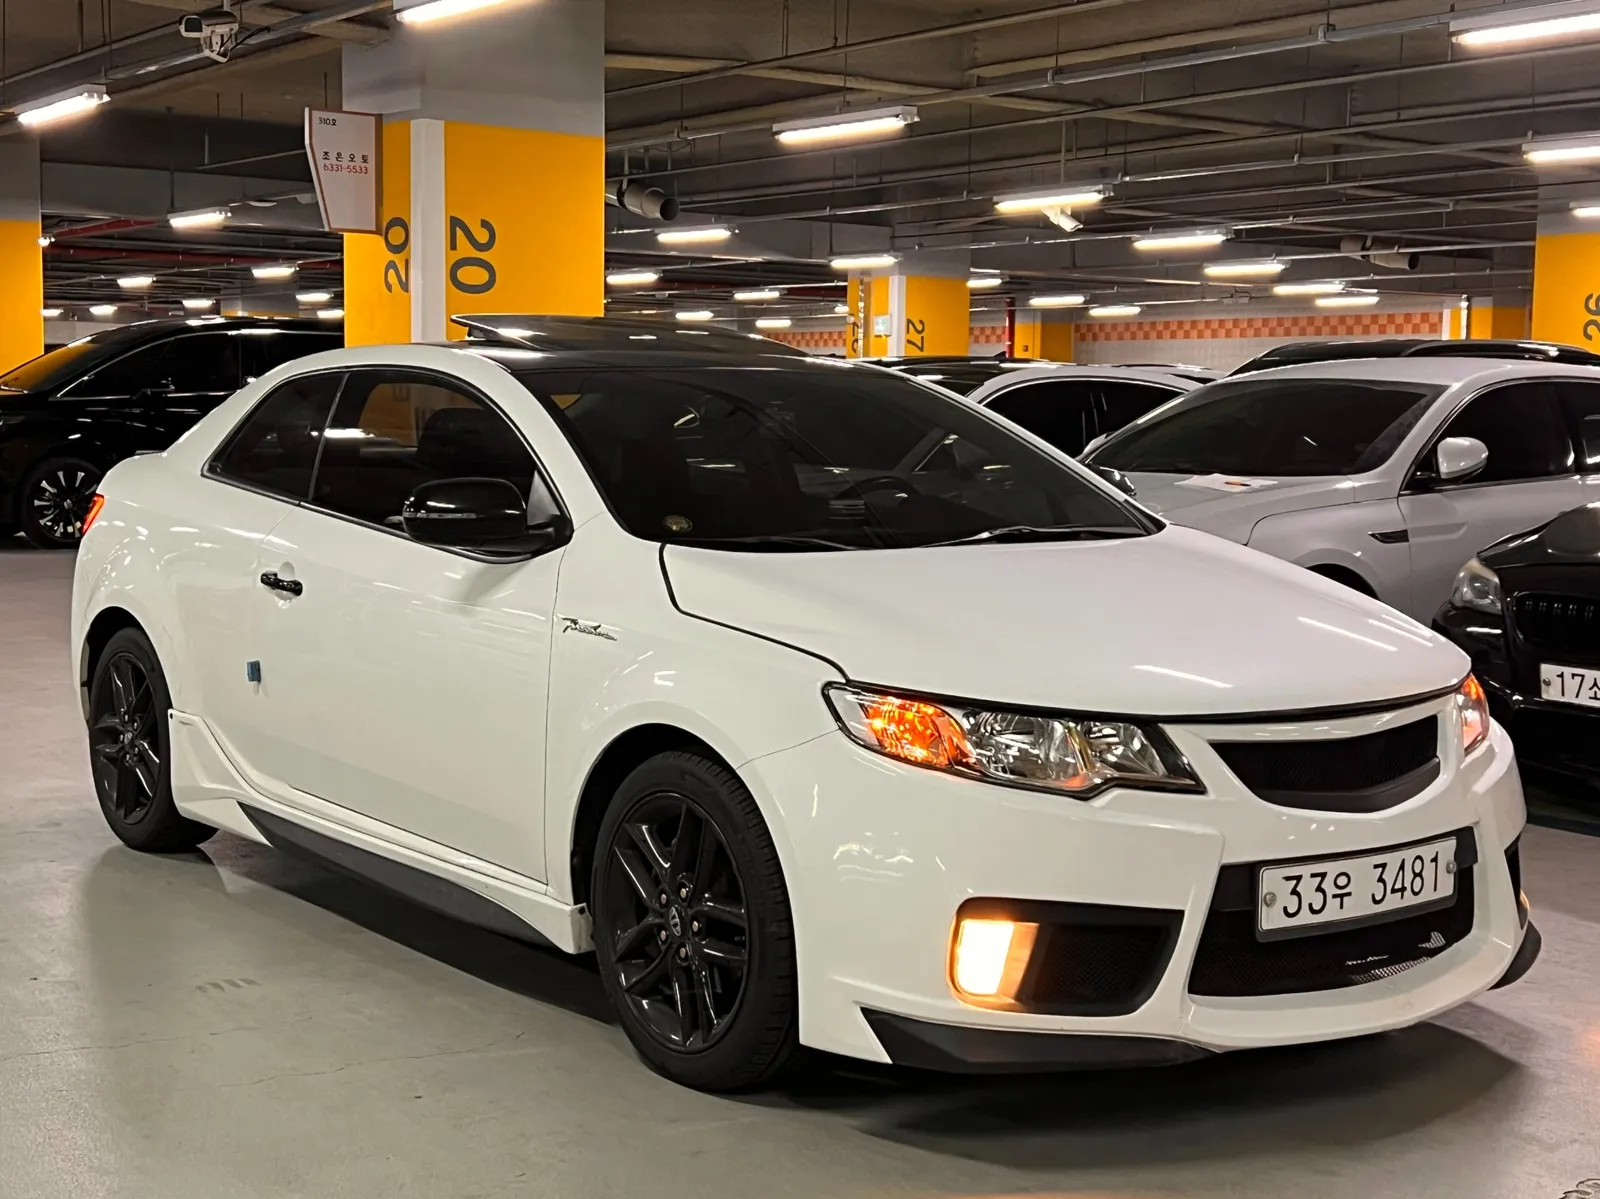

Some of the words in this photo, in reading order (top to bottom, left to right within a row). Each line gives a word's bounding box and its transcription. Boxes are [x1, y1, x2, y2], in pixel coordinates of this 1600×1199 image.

[318, 117, 337, 126] 310호
[323, 163, 368, 174] 6331-5533
[384, 217, 409, 294] 20
[450, 216, 496, 294] 20
[907, 318, 925, 352] 27
[1282, 871, 1352, 918] 33우
[1371, 851, 1439, 905] 3481
